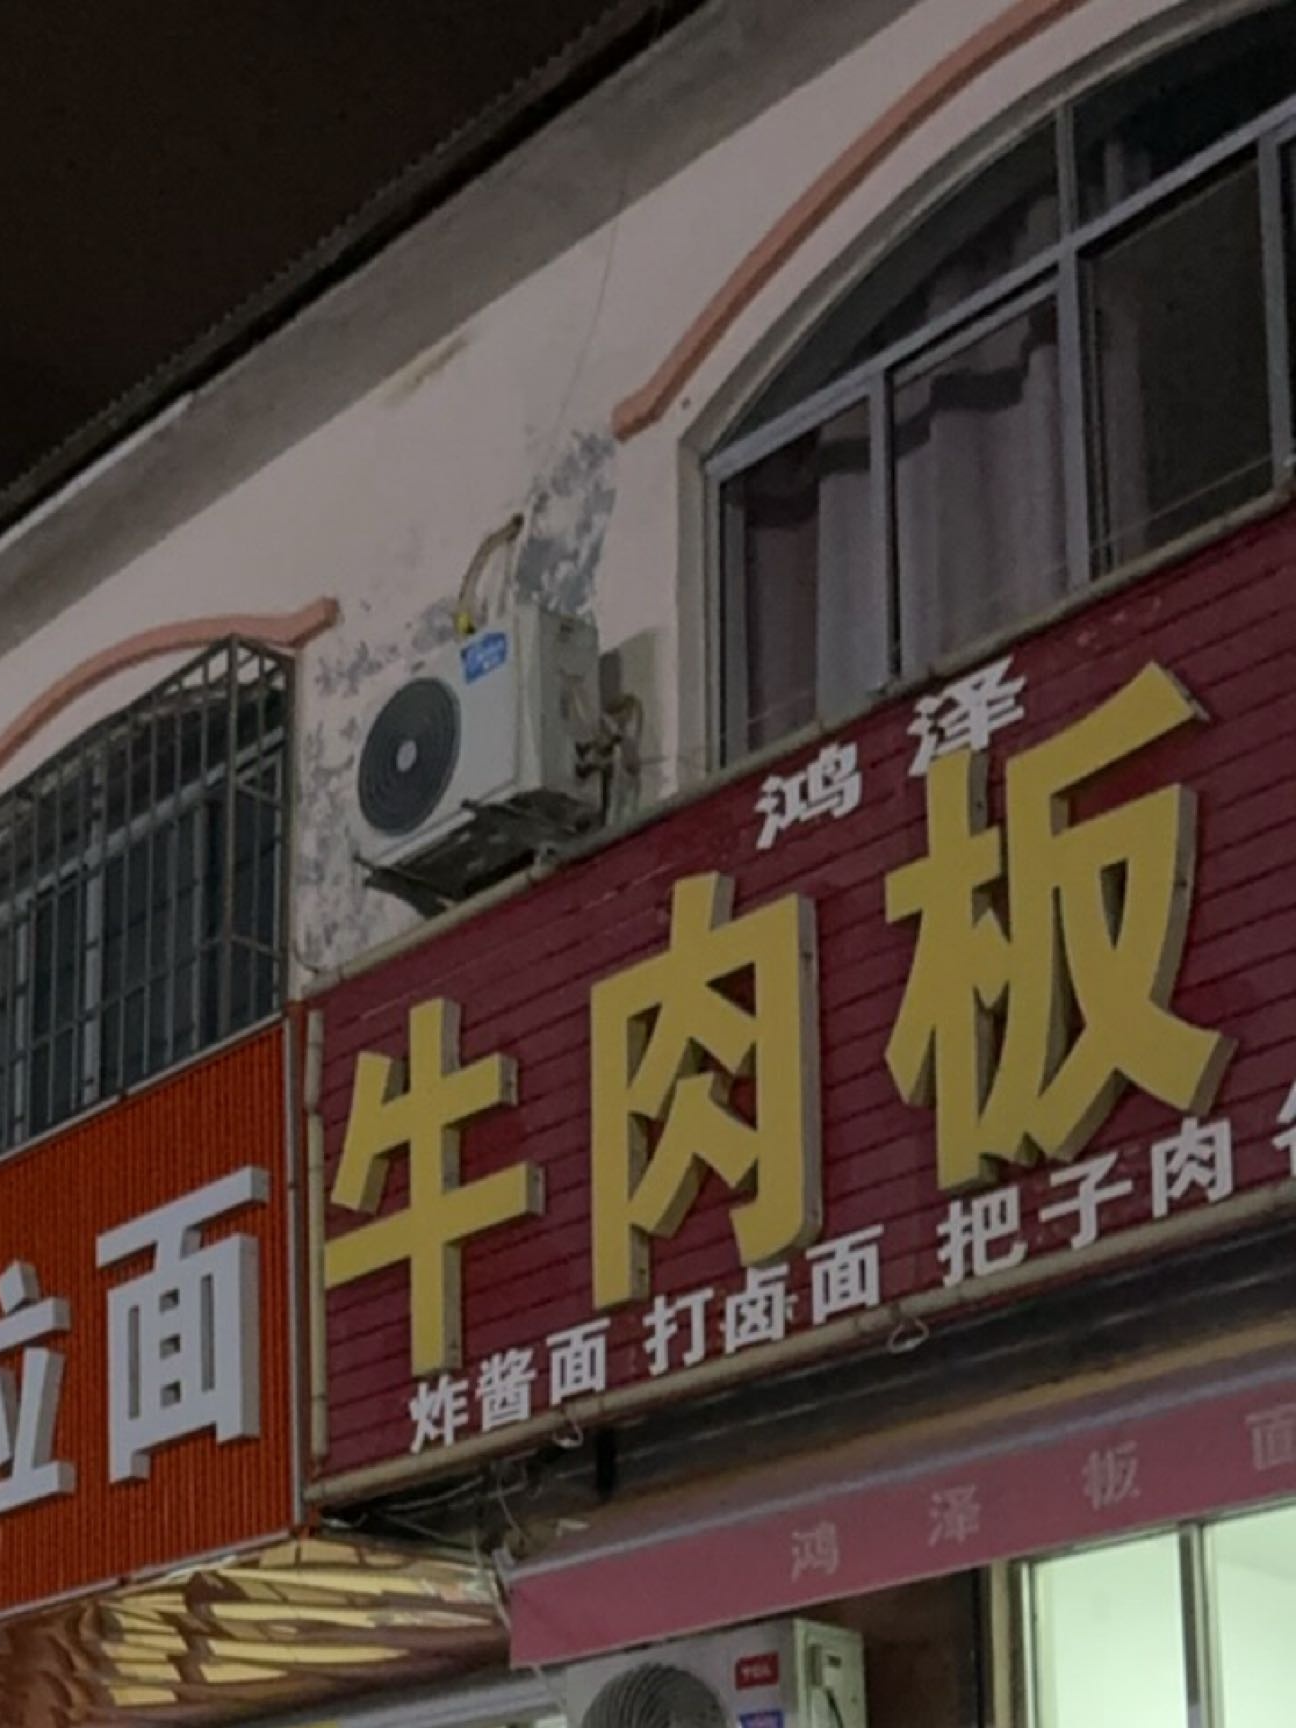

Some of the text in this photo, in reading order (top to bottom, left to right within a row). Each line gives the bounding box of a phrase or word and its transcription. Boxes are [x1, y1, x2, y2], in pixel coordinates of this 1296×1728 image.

[755, 658, 1026, 848] 鸿泽
[324, 660, 1236, 1378] 牛肉板
[408, 1315, 611, 1453] 炸酱面
[644, 1224, 886, 1376] 打卤面
[939, 1117, 1234, 1288] 把子肉
[790, 1406, 1296, 1584] 鸿泽板面
